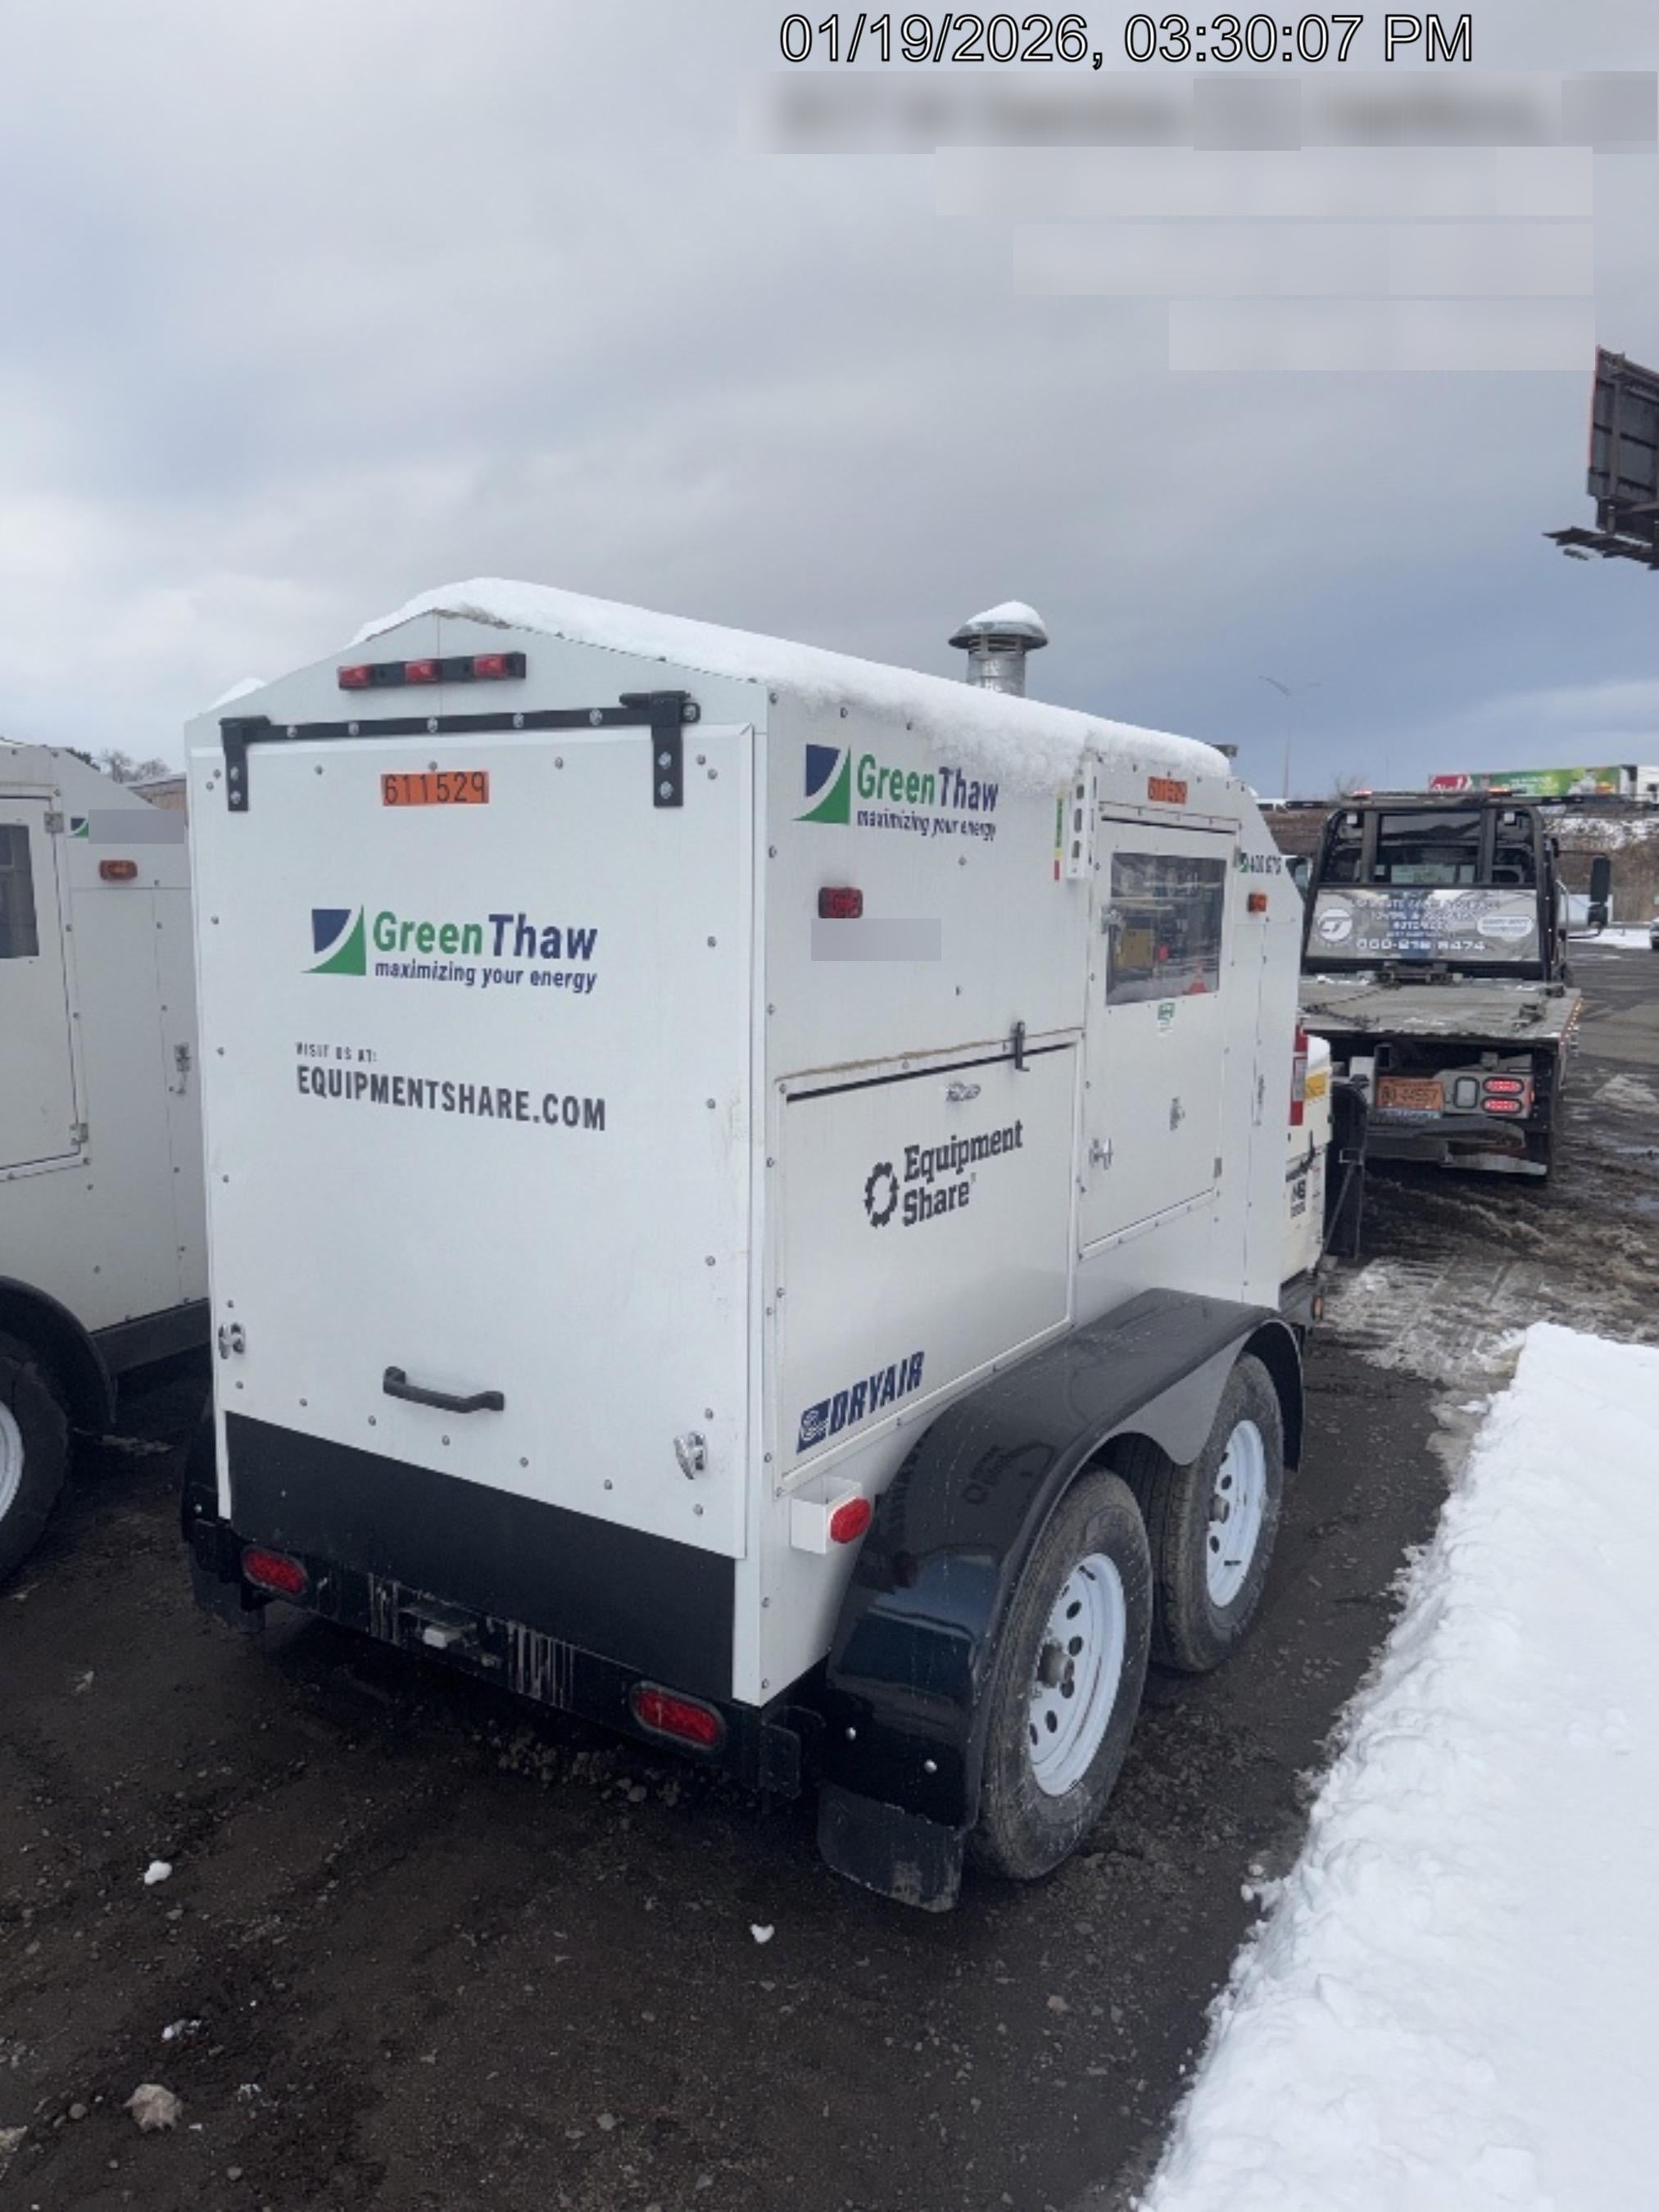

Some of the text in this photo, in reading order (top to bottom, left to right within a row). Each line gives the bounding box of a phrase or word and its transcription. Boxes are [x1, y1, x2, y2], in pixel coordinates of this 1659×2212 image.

[385, 772, 485, 805] 611529
[857, 809, 996, 841] maximizing your energy
[374, 959, 598, 994] maximizing your energy
[296, 1041, 329, 1058] VISIT
[335, 1046, 351, 1059] US
[296, 1065, 606, 1131] EQUIPMENTSHARE.COM
[904, 1119, 1023, 1185] Equipment
[903, 1181, 970, 1227] Share
[828, 1351, 925, 1435] DRYAIR
